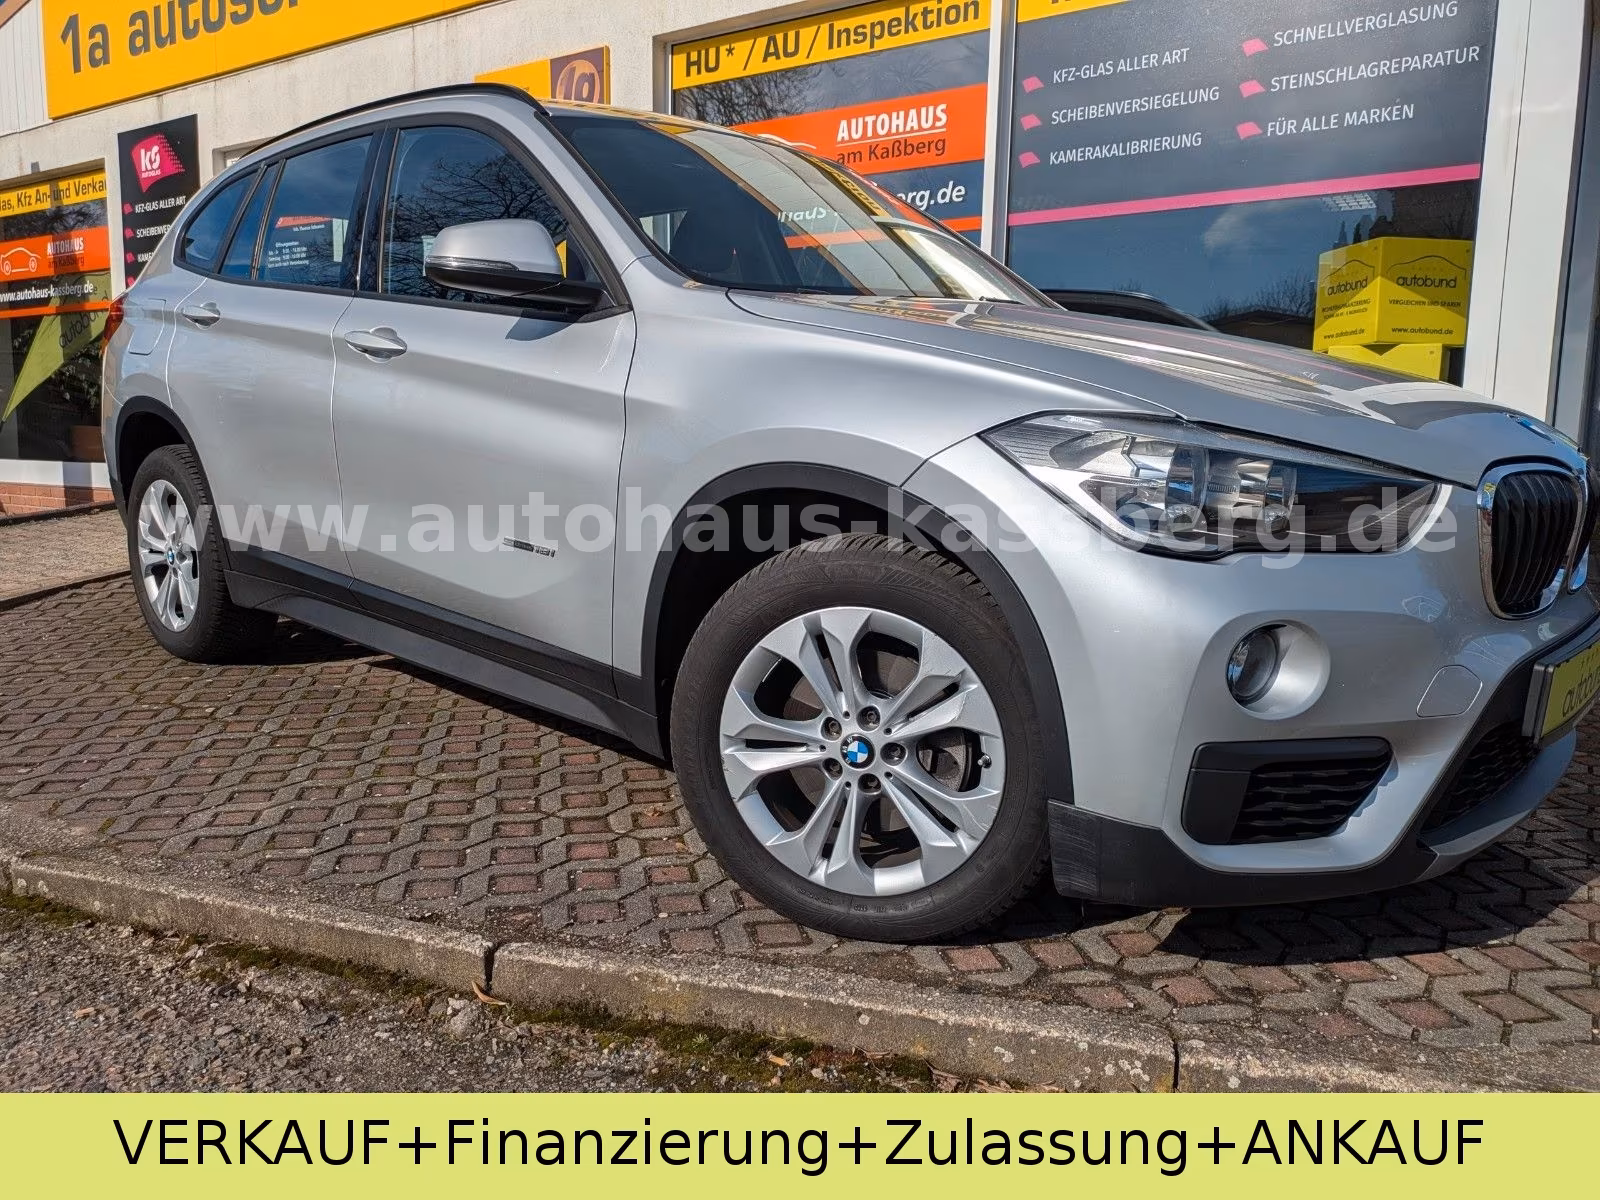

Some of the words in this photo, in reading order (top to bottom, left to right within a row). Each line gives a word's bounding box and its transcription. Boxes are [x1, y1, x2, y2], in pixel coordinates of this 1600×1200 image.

[762, 30, 800, 63] AU
[827, 0, 980, 51] Inspektion
[1273, 1, 1458, 47] SCHNELLVERGLASUNG
[60, 13, 111, 74] 1a
[1053, 61, 1114, 84] KFZ-GLAS
[1116, 53, 1159, 73] ALLER
[1161, 48, 1190, 65] ART
[1270, 46, 1480, 92] STEINSCHLAGREPARATUR
[1051, 86, 1220, 125] SCHEIBENVERSIEGELUNG
[1267, 117, 1297, 136] FÜR
[1301, 113, 1339, 133] ALLE
[1344, 103, 1415, 127] MARKEN
[837, 104, 948, 142] AUTOHAUS
[836, 151, 863, 166] am
[868, 139, 946, 163] Kaßberg
[1050, 132, 1202, 165] KAMERAKALIBRIERUNG
[0, 199, 15, 212] as,
[16, 191, 33, 209] Kfz
[35, 188, 51, 204] An-
[53, 182, 71, 201] und
[135, 201, 159, 213] KFZ-GLAS
[159, 199, 175, 209] ALLER
[175, 196, 186, 205] ART
[47, 238, 84, 255] AUTOHAUS
[1327, 276, 1369, 296] autobund
[1396, 274, 1458, 289] autobund
[1391, 326, 1454, 336] www.autobund.de
